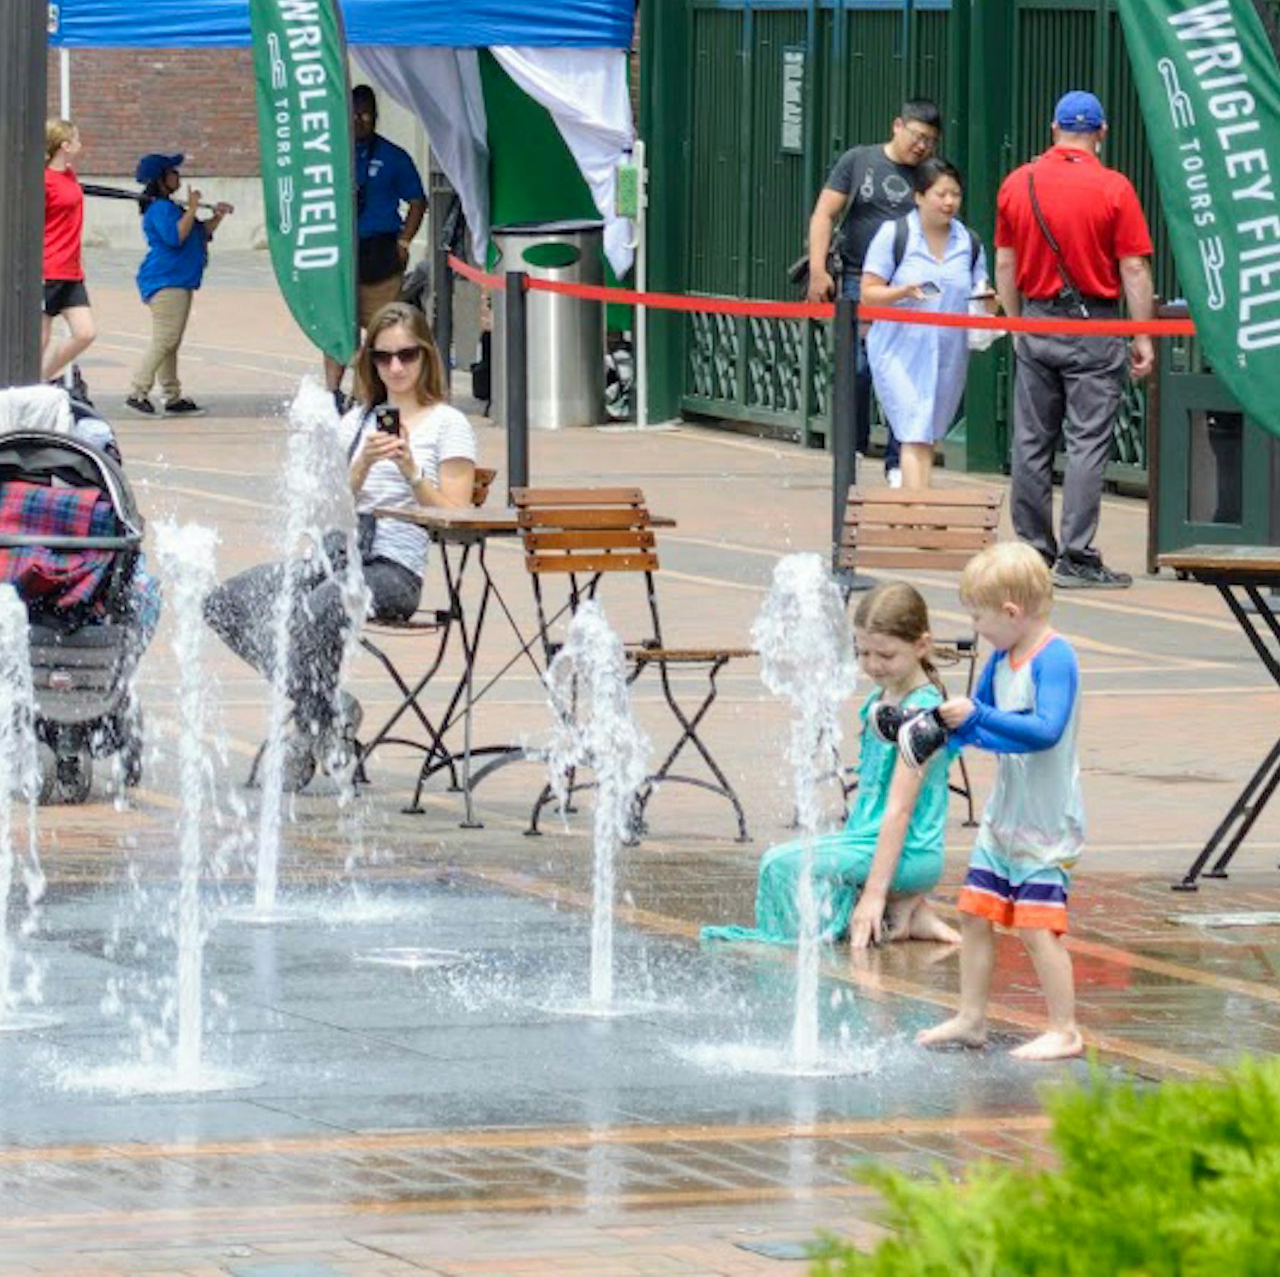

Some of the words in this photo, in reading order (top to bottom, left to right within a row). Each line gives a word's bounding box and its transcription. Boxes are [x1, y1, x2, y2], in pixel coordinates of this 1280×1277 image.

[275, 98, 292, 167] TOURS
[294, 164, 339, 269] FIELD
[1179, 138, 1216, 228] TOURS
